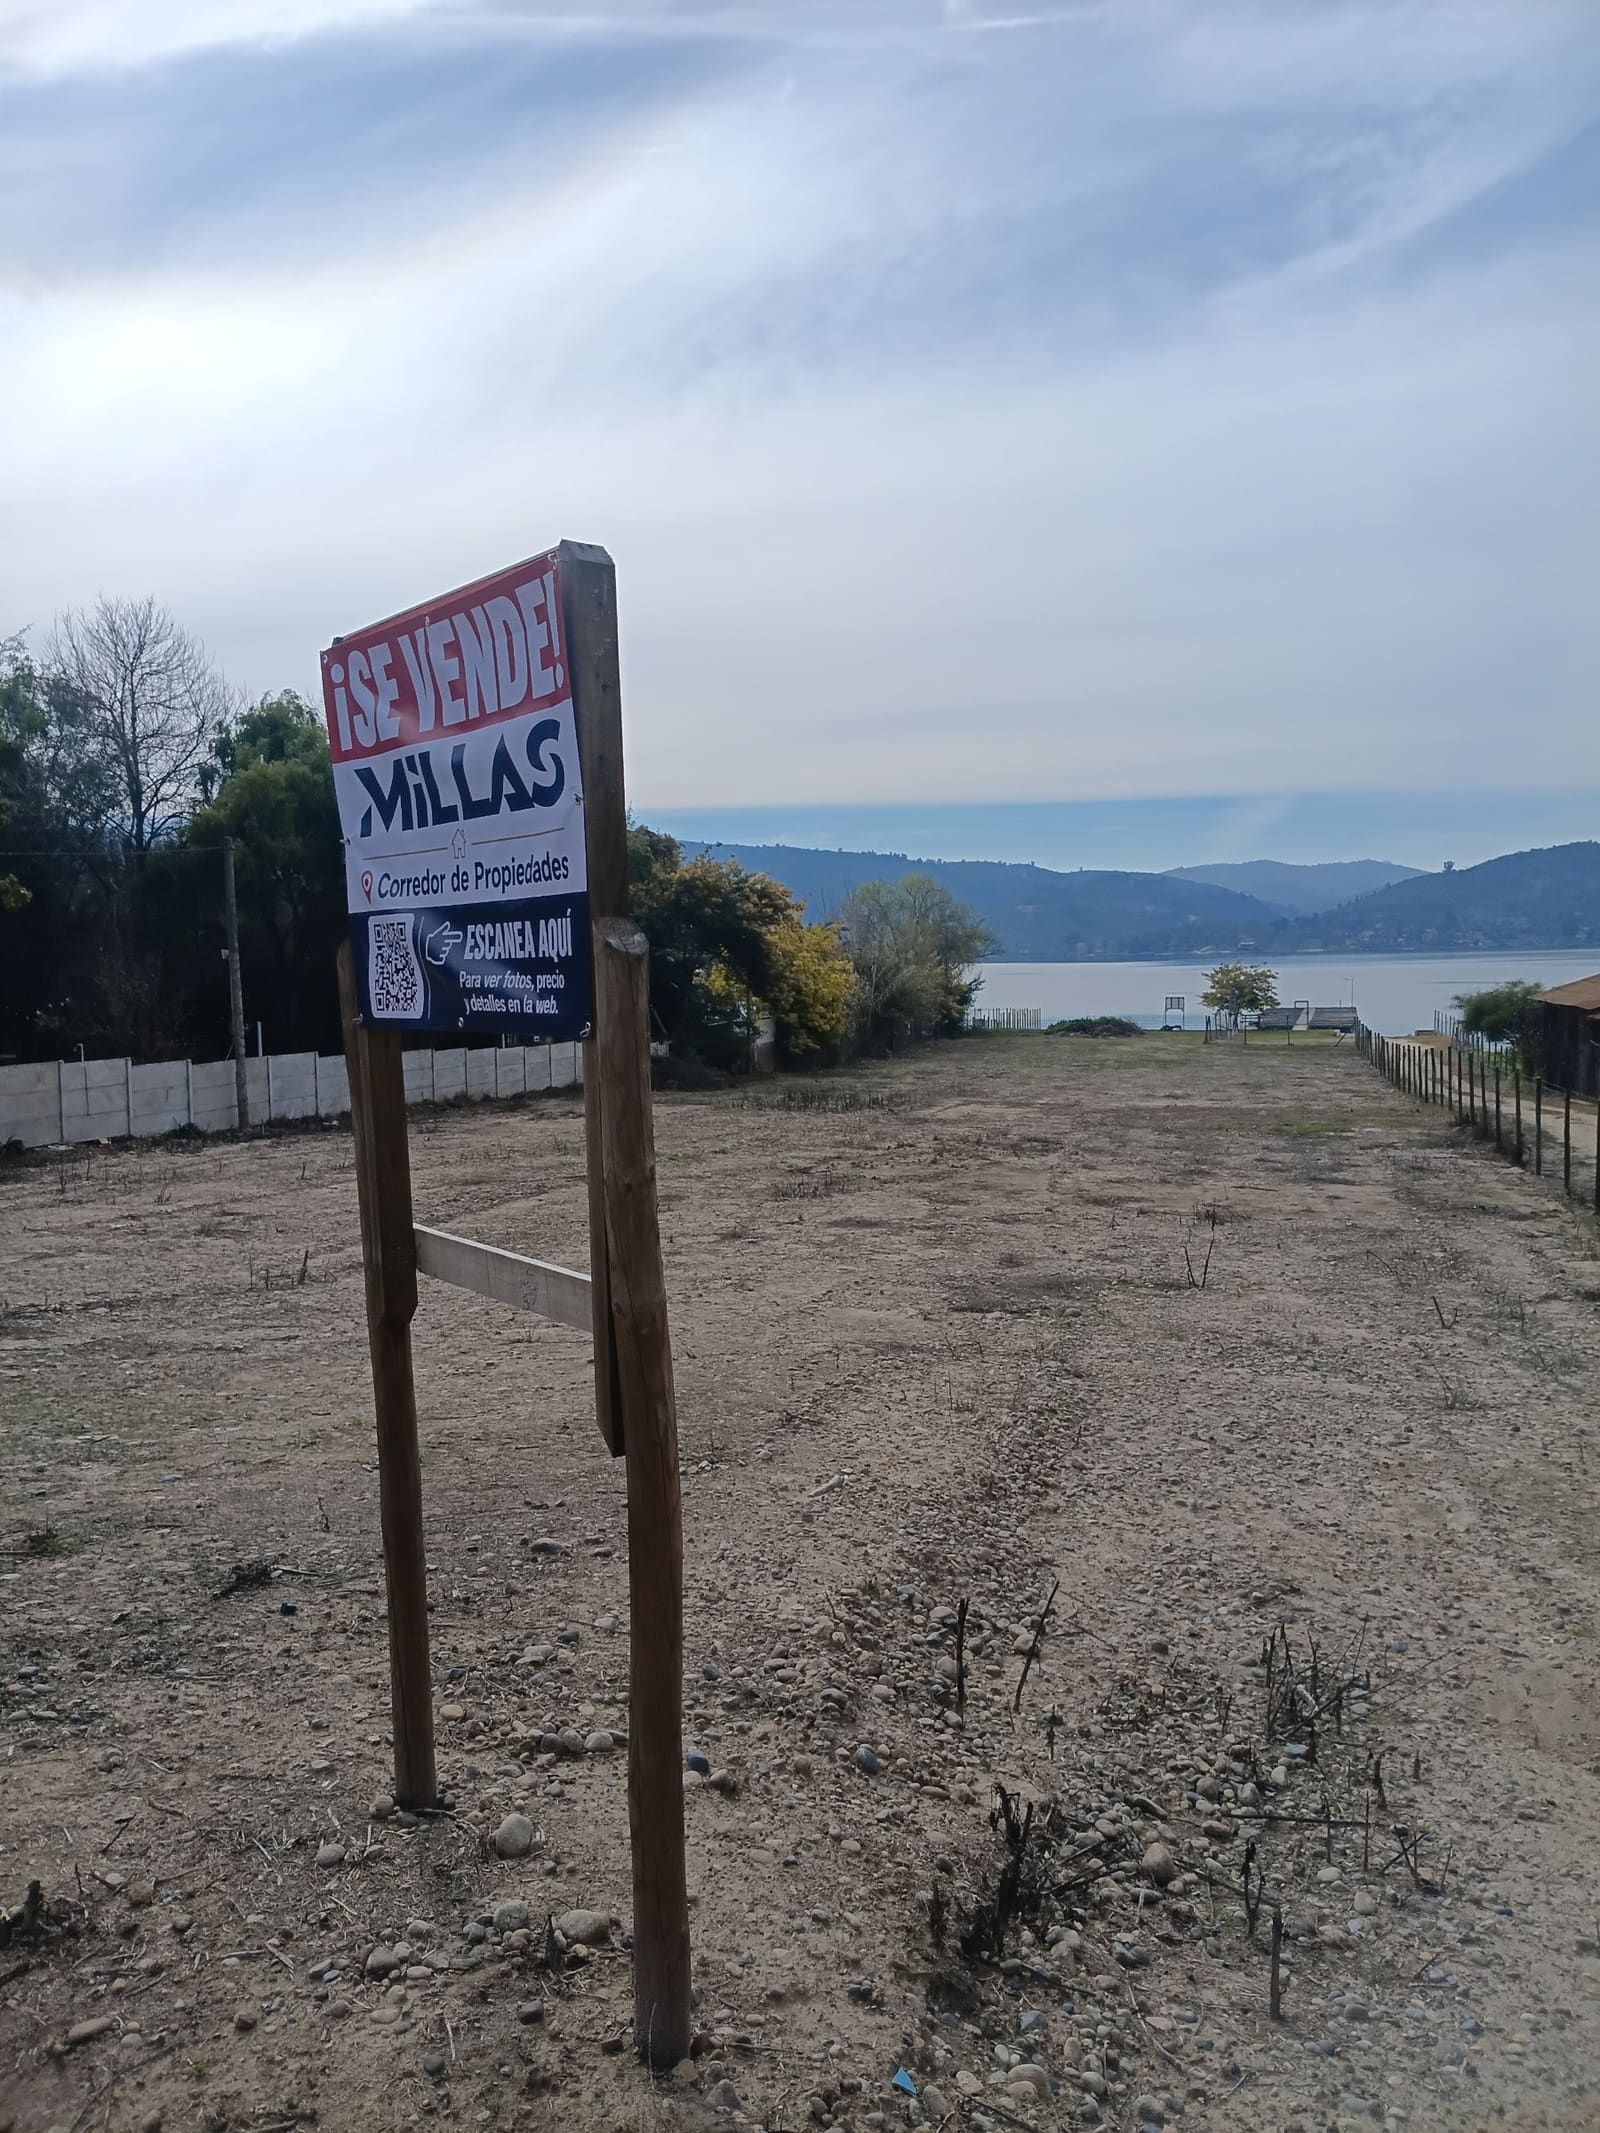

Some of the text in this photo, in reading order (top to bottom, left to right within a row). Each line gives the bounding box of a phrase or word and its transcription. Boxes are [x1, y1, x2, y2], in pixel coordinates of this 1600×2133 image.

[397, 570, 564, 733] VENDE!
[377, 851, 569, 898] Corredor de Propiedades
[463, 908, 573, 962] ESCANEA AQUÍ
[459, 970, 565, 992] Para ver fotos, precio
[464, 994, 559, 1015] y detalles en la web.
